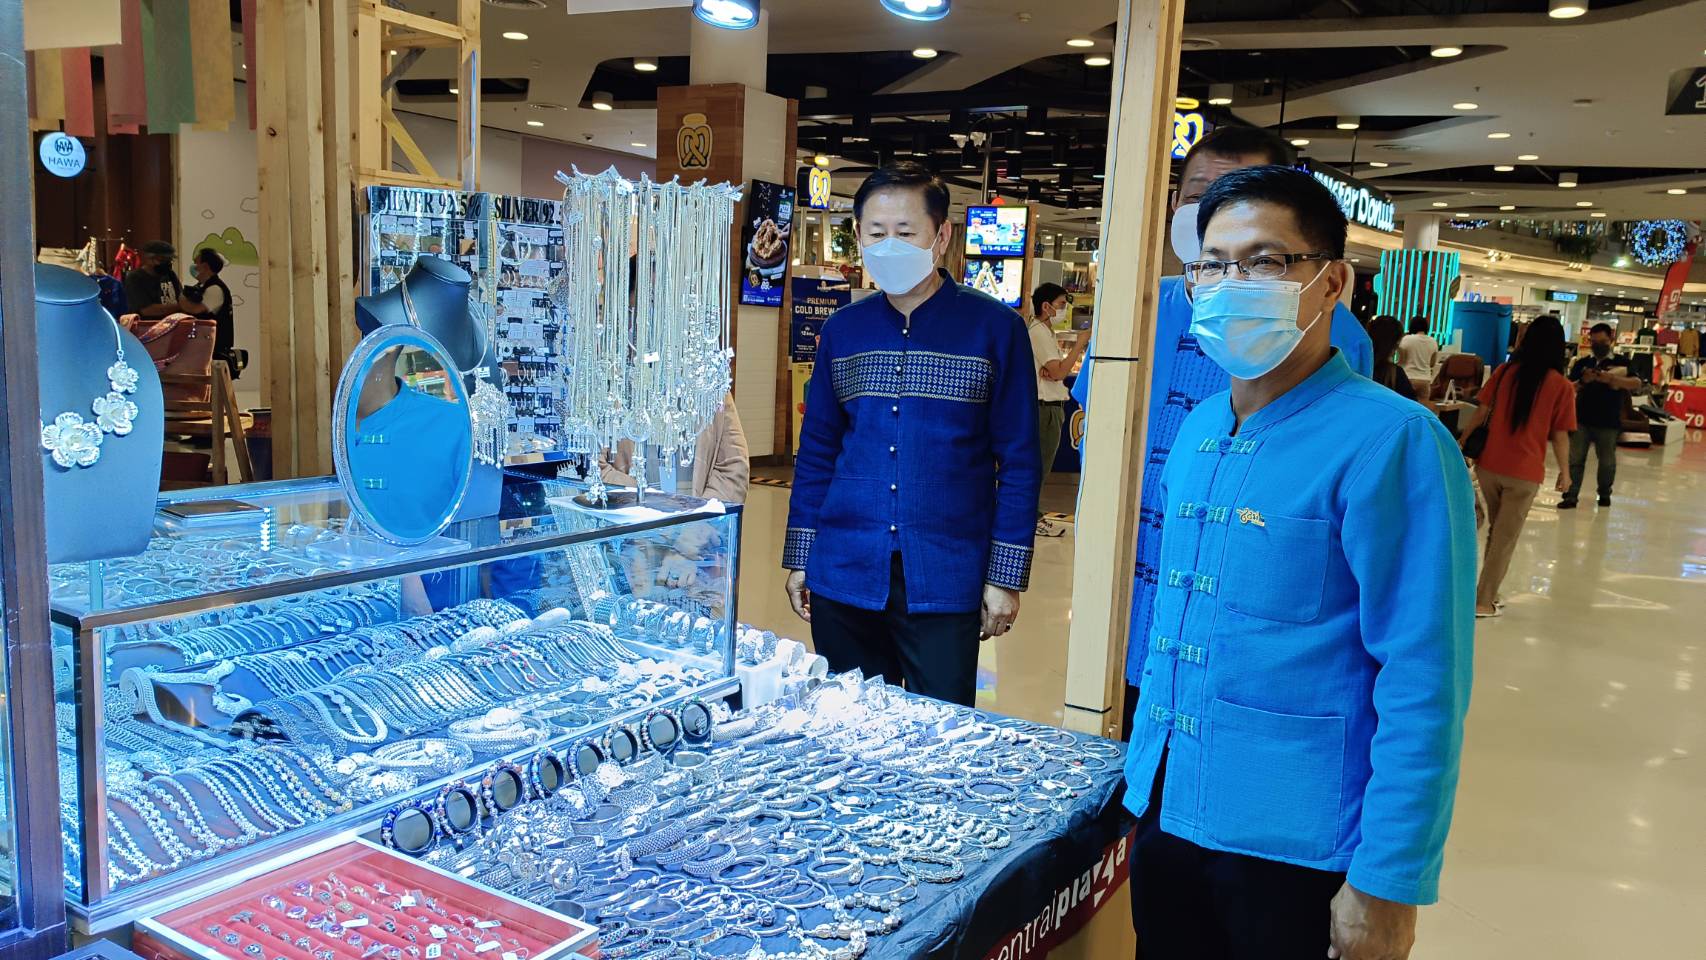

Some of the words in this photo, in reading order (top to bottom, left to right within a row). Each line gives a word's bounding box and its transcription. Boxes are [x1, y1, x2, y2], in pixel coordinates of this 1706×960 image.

[48, 156, 81, 168] HAWA
[494, 195, 540, 223] SILVER
[807, 297, 838, 306] PREMIUM
[795, 305, 813, 314] COLD
[814, 307, 835, 316] BREW
[1666, 389, 1684, 403] 70
[1685, 413, 1704, 427] 70
